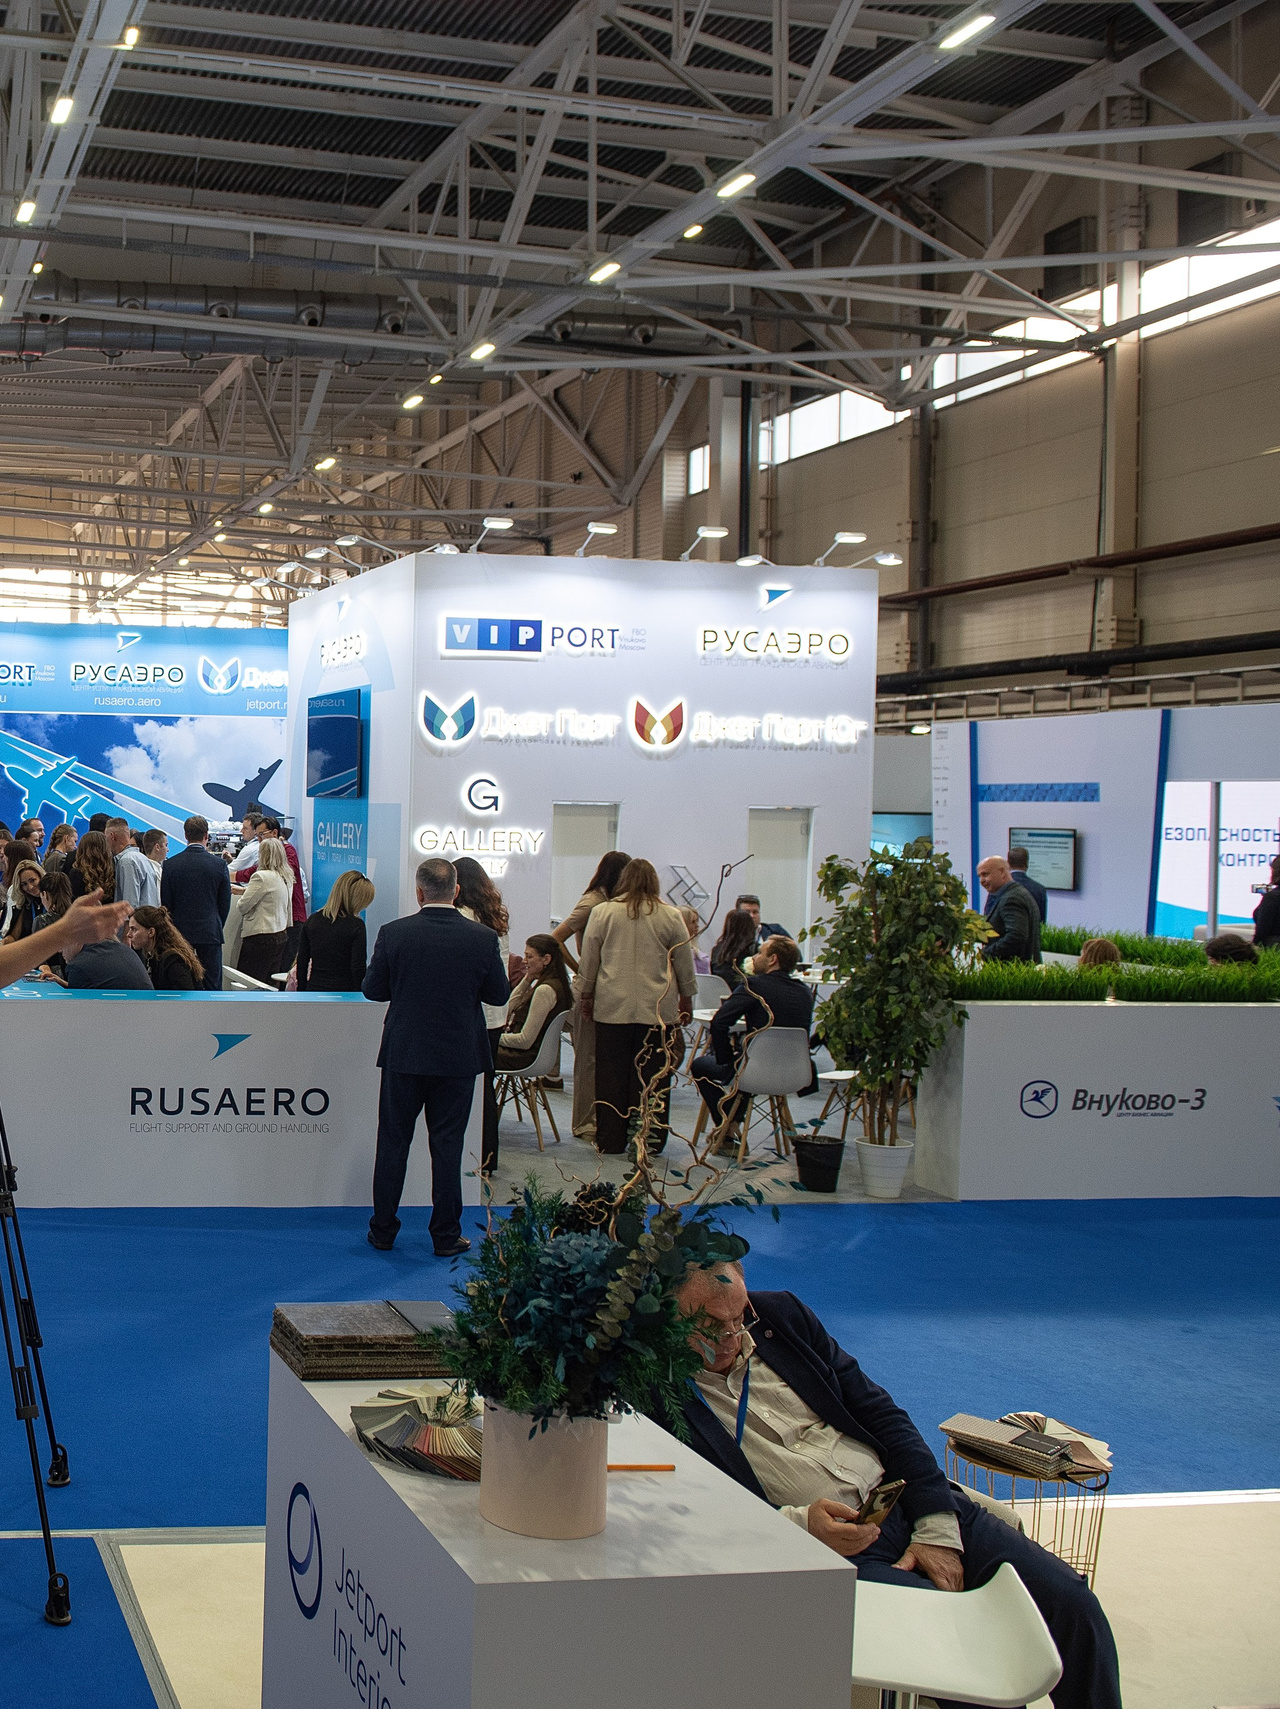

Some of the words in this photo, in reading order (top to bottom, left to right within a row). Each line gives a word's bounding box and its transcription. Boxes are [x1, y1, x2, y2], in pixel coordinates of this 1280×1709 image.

[452, 624, 535, 645] VIP
[551, 627, 619, 649] PORT
[703, 630, 849, 655] РУСАЭРО
[74, 665, 184, 682] РУСАЭРО
[94, 697, 161, 707] rusaero.aero
[317, 822, 363, 850] GALLERY
[420, 830, 544, 853] GALLERY
[1165, 827, 1280, 842] ЕЗОПСНОСТЬ
[130, 1087, 330, 1116] RUSAERO
[1071, 1087, 1208, 1117] Внуково-3
[130, 1123, 162, 1133] FLIGHT
[165, 1123, 210, 1133] SUPPORT
[212, 1123, 233, 1133] AND
[235, 1123, 278, 1133] GROUND
[281, 1123, 330, 1133] HANDLING
[335, 1547, 407, 1687] Jetport
[333, 1608, 393, 1709] Interi
